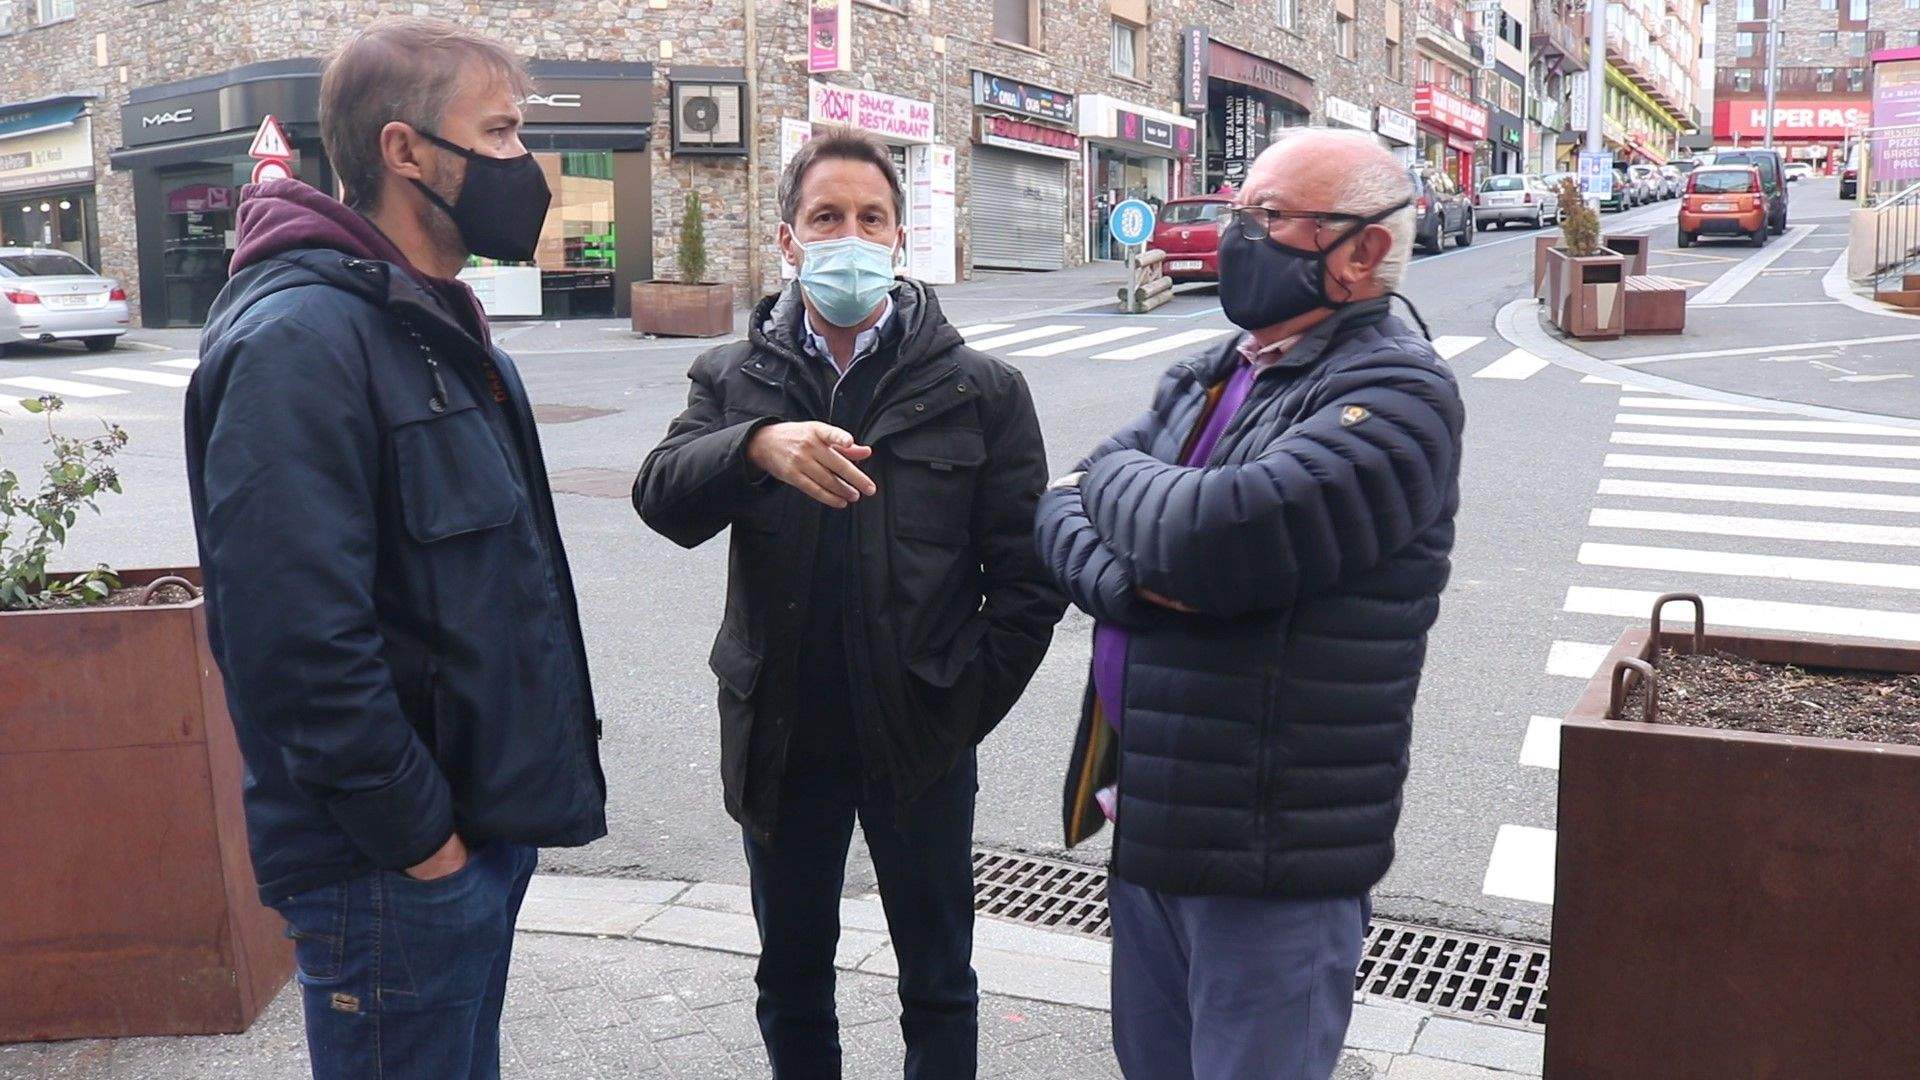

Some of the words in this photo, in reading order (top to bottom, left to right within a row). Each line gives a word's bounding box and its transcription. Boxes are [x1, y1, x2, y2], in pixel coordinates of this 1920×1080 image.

[1192, 30, 1201, 101] RESTAURANT
[516, 94, 581, 107] AC
[1235, 98, 1244, 125] SPIRIT
[143, 109, 193, 128] MAC
[909, 104, 930, 121] BAR
[1226, 95, 1234, 136] ZEALAND
[1750, 108, 1815, 128] HPER
[859, 112, 930, 138] RESTAURANT
[1226, 139, 1234, 159] NEW
[1235, 127, 1244, 157] RUGBY
